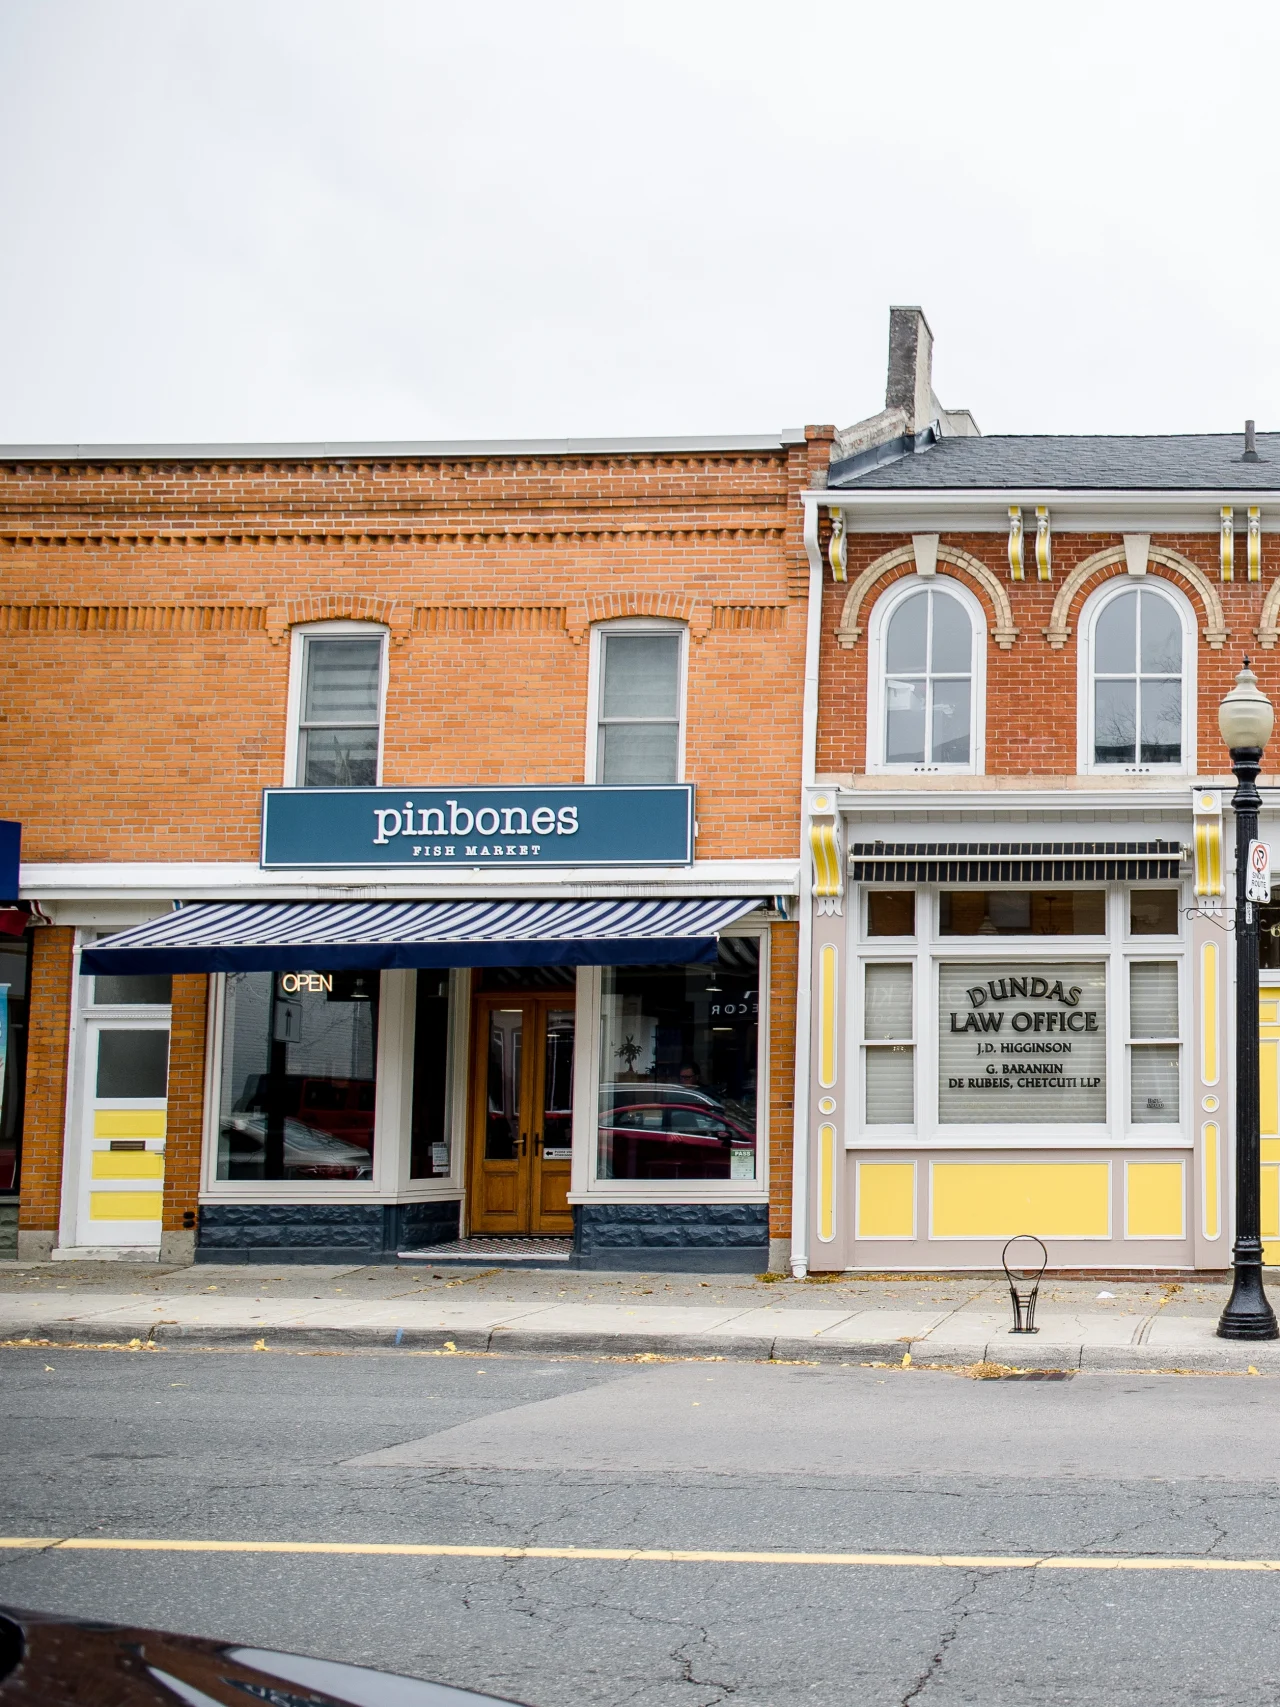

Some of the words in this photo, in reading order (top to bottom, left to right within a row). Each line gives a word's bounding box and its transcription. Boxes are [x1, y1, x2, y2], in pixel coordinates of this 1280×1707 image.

[373, 801, 579, 844] pinbones
[412, 846, 455, 856] FISH
[465, 845, 541, 856] MARKET
[1251, 880, 1267, 888] ROUTE
[282, 973, 333, 992] OPEN
[966, 977, 1082, 1008] DUNDAS
[950, 1012, 1004, 1032] LAW
[1011, 1011, 1099, 1032] OFFICE
[977, 1043, 996, 1055] J.D.
[1000, 1042, 1072, 1053] HIGGINSON
[986, 1064, 998, 1074] G.
[1002, 1064, 1063, 1074] BARANKIN
[949, 1078, 964, 1088] DE
[967, 1078, 1013, 1089] RUBEIS,
[1017, 1078, 1076, 1088] CHETCUTI
[1080, 1078, 1101, 1088] LLP
